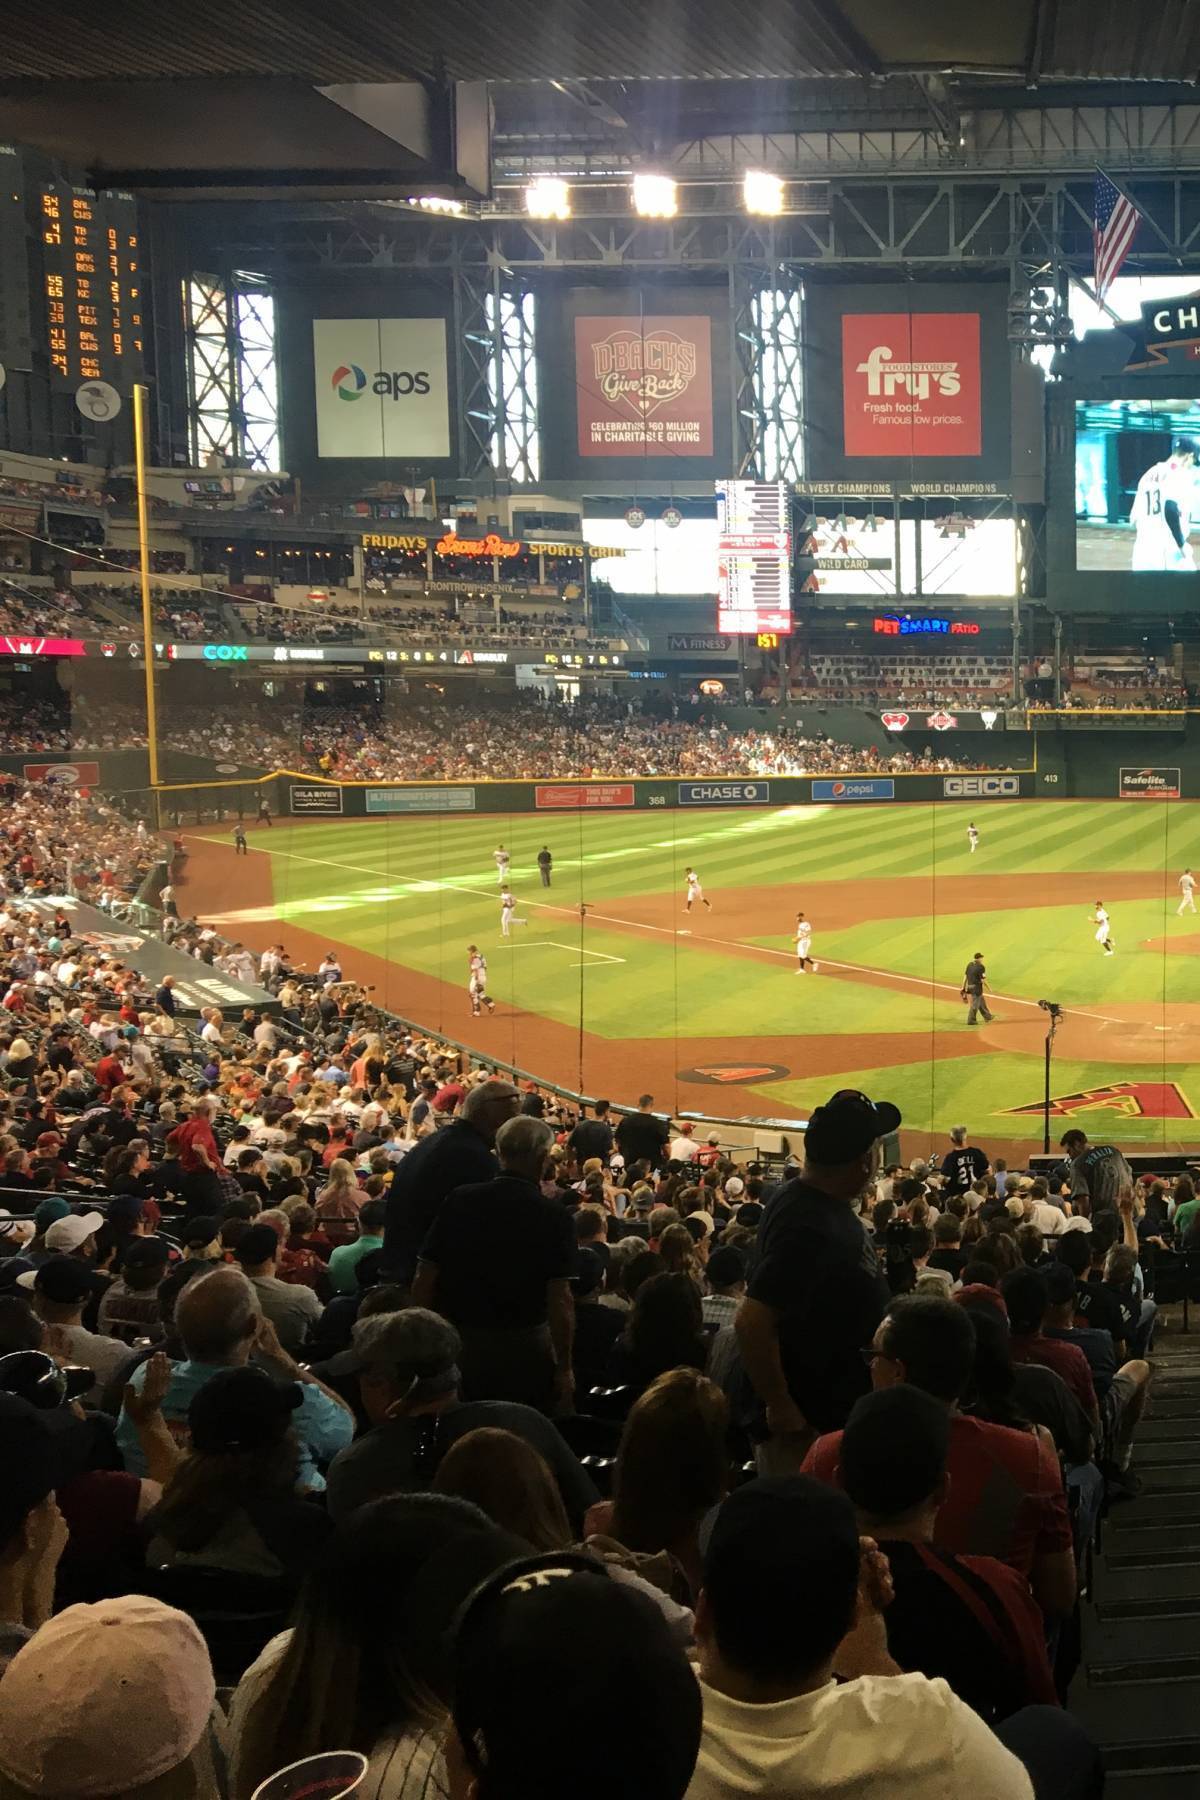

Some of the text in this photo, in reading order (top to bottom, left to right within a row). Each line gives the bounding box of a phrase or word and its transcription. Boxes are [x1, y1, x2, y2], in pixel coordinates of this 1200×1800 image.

[856, 346, 961, 399] fry's
[372, 370, 431, 401] aps
[604, 372, 684, 399] Give Back
[863, 402, 923, 413] Fresh food.
[666, 421, 700, 431] MILLION
[872, 414, 965, 427] Famous low prices.
[591, 432, 602, 442] IN
[667, 431, 700, 442] GIVING
[809, 483, 835, 494] WEST
[837, 483, 892, 495] CHAMPIONS
[911, 483, 997, 495] WORLD CHAMPIONS
[361, 534, 428, 549] FRIDAY'S
[528, 543, 584, 557] SPORTS
[818, 558, 869, 569] WILD CARD
[951, 623, 980, 634] PATIO
[690, 639, 726, 649] FITNESS
[203, 645, 247, 660] COX
[386, 651, 398, 661] 12
[1044, 774, 1058, 783] 413
[1123, 775, 1165, 785] Safelite
[846, 783, 873, 796] pepsi
[946, 777, 1019, 795] GEICO
[691, 787, 741, 799] CHASE
